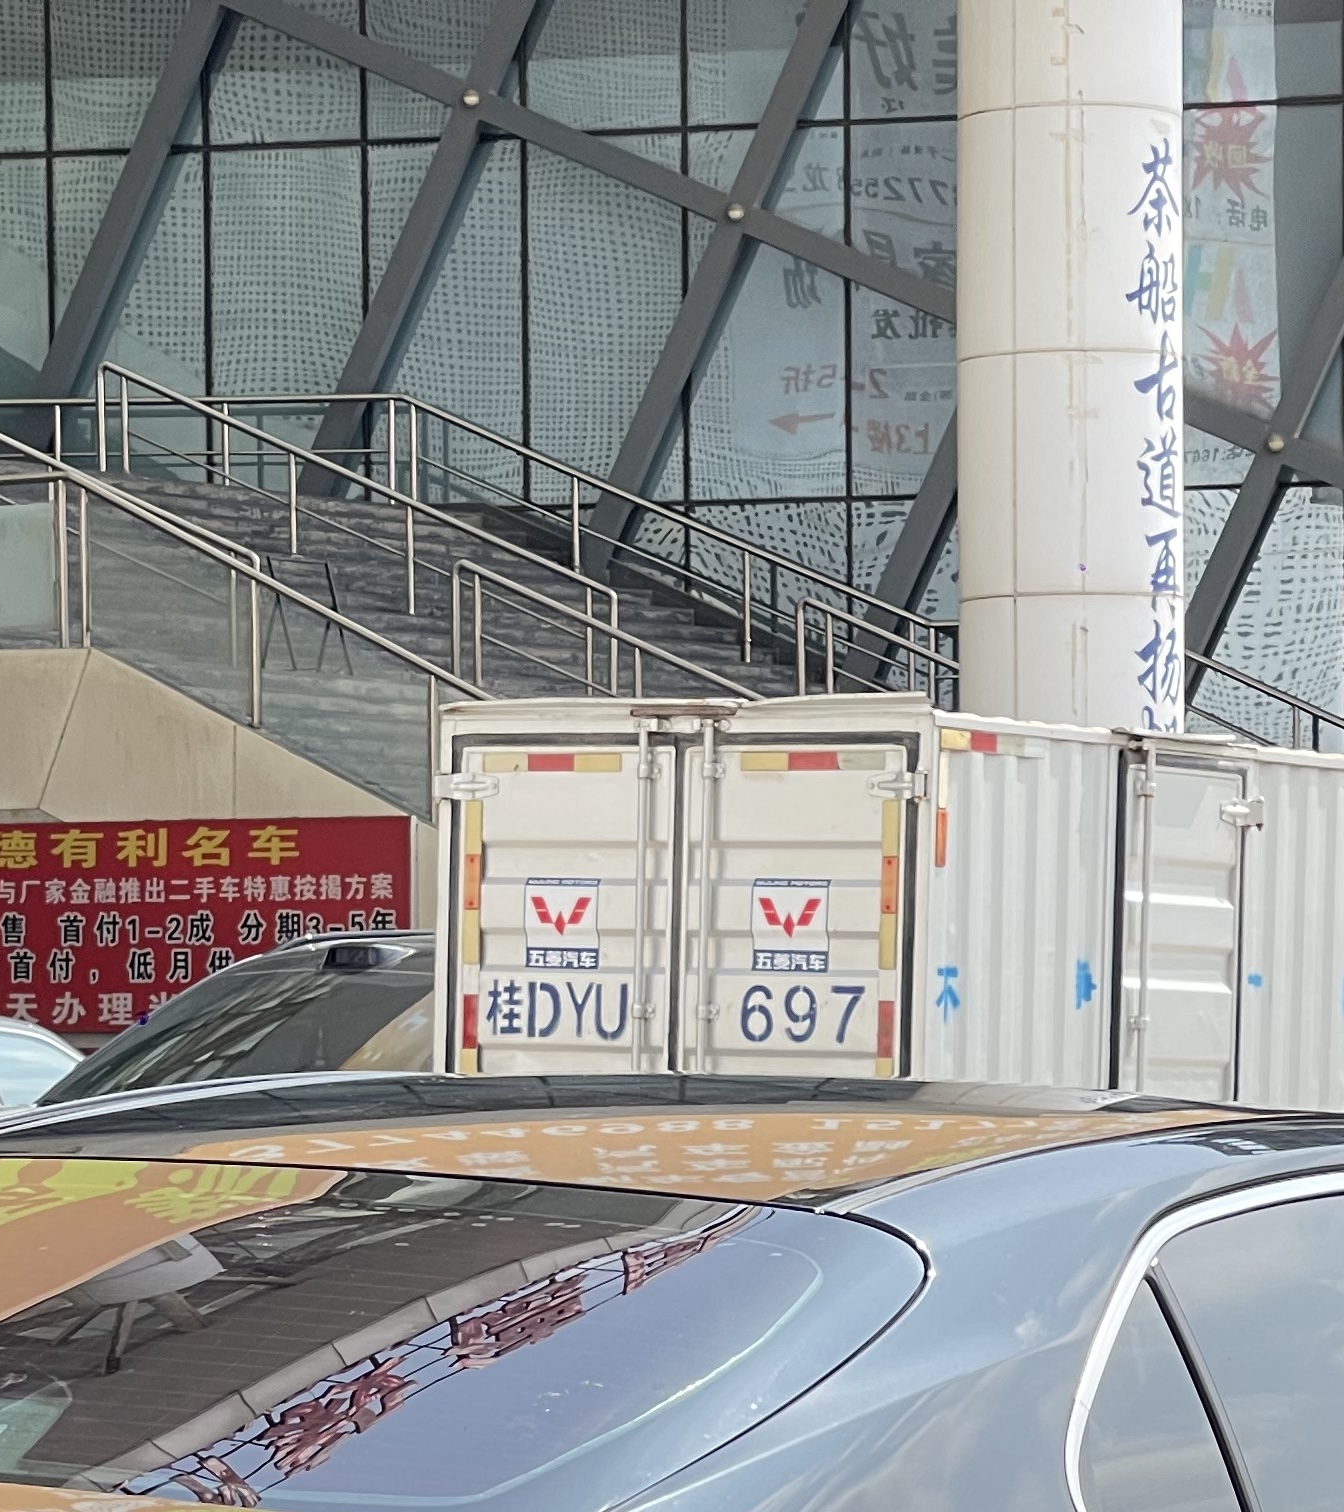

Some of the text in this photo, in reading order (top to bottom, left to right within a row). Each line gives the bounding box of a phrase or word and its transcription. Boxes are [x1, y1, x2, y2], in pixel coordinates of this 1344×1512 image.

[528, 949, 598, 970] 五菱汽车
[755, 951, 827, 973] 五菱汽车
[486, 977, 866, 1045] 桂DYU 697
